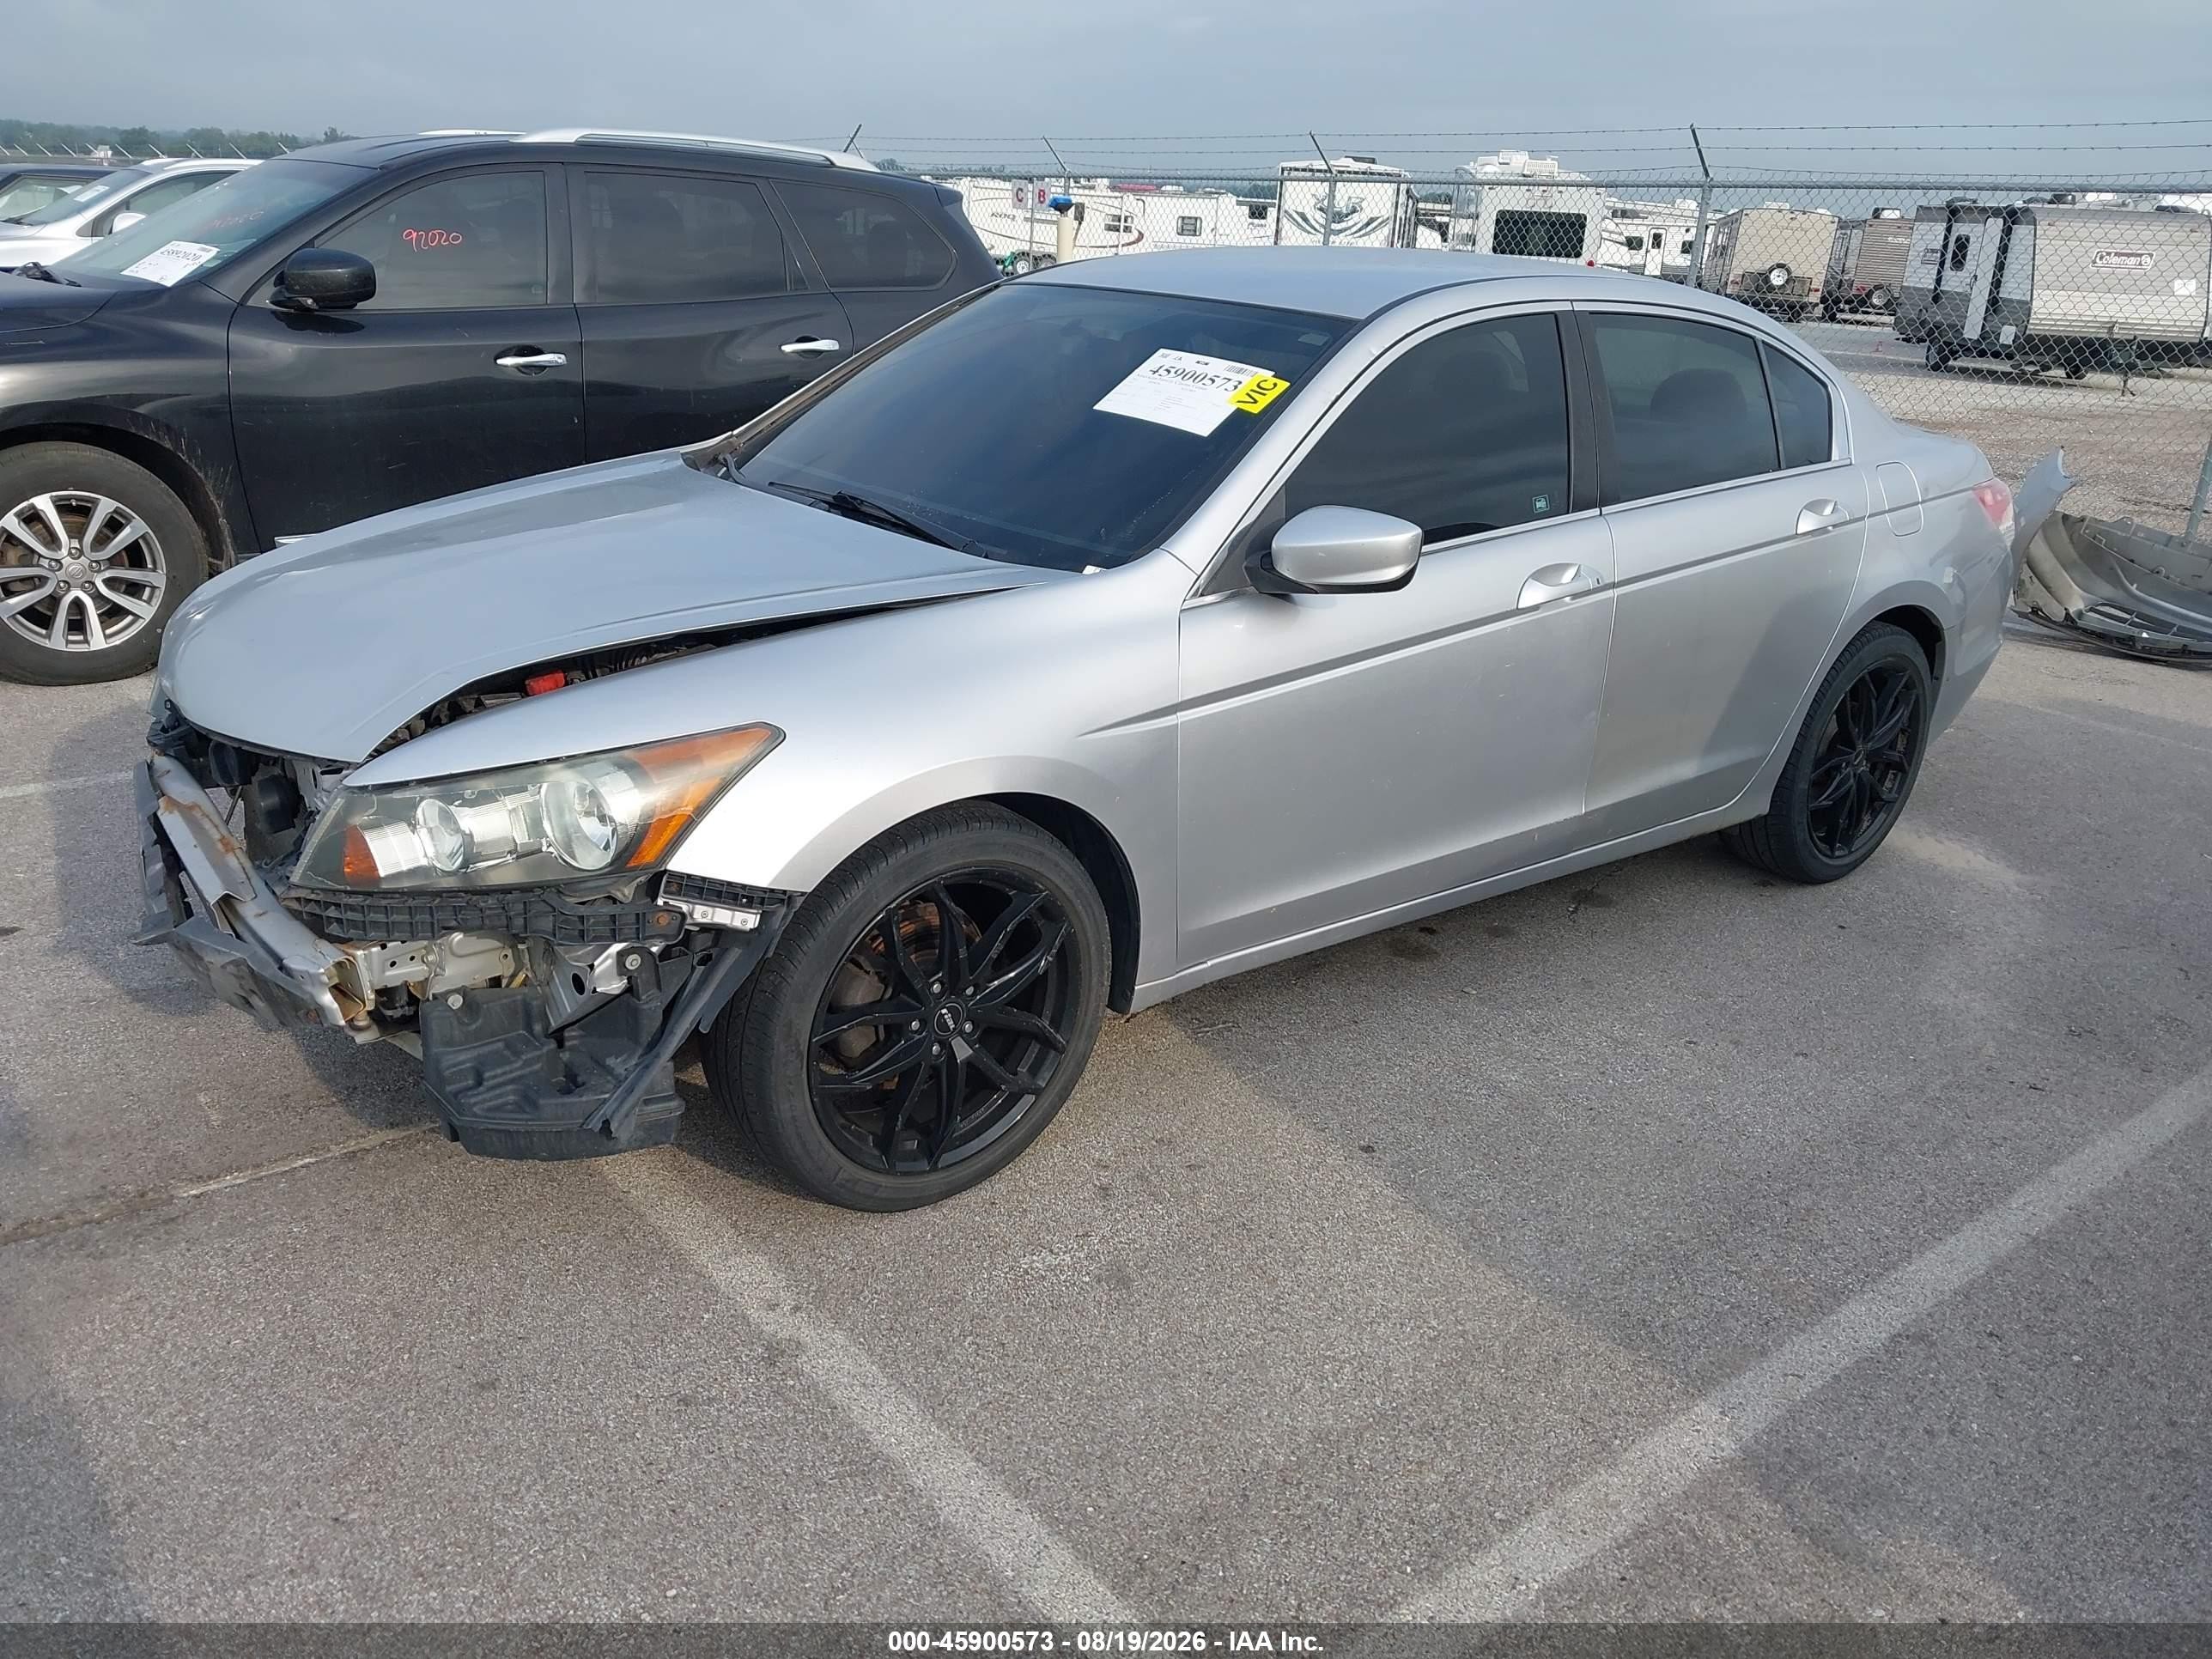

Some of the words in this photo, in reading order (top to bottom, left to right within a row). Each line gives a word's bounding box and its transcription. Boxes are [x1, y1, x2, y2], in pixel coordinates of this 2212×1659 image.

[1016, 188, 1024, 203] C
[1037, 189, 1046, 204] B
[403, 228, 463, 252] 92020
[2095, 252, 2141, 265] Coleman
[1149, 364, 1243, 392] 45900573
[1237, 379, 1279, 406] VIC
